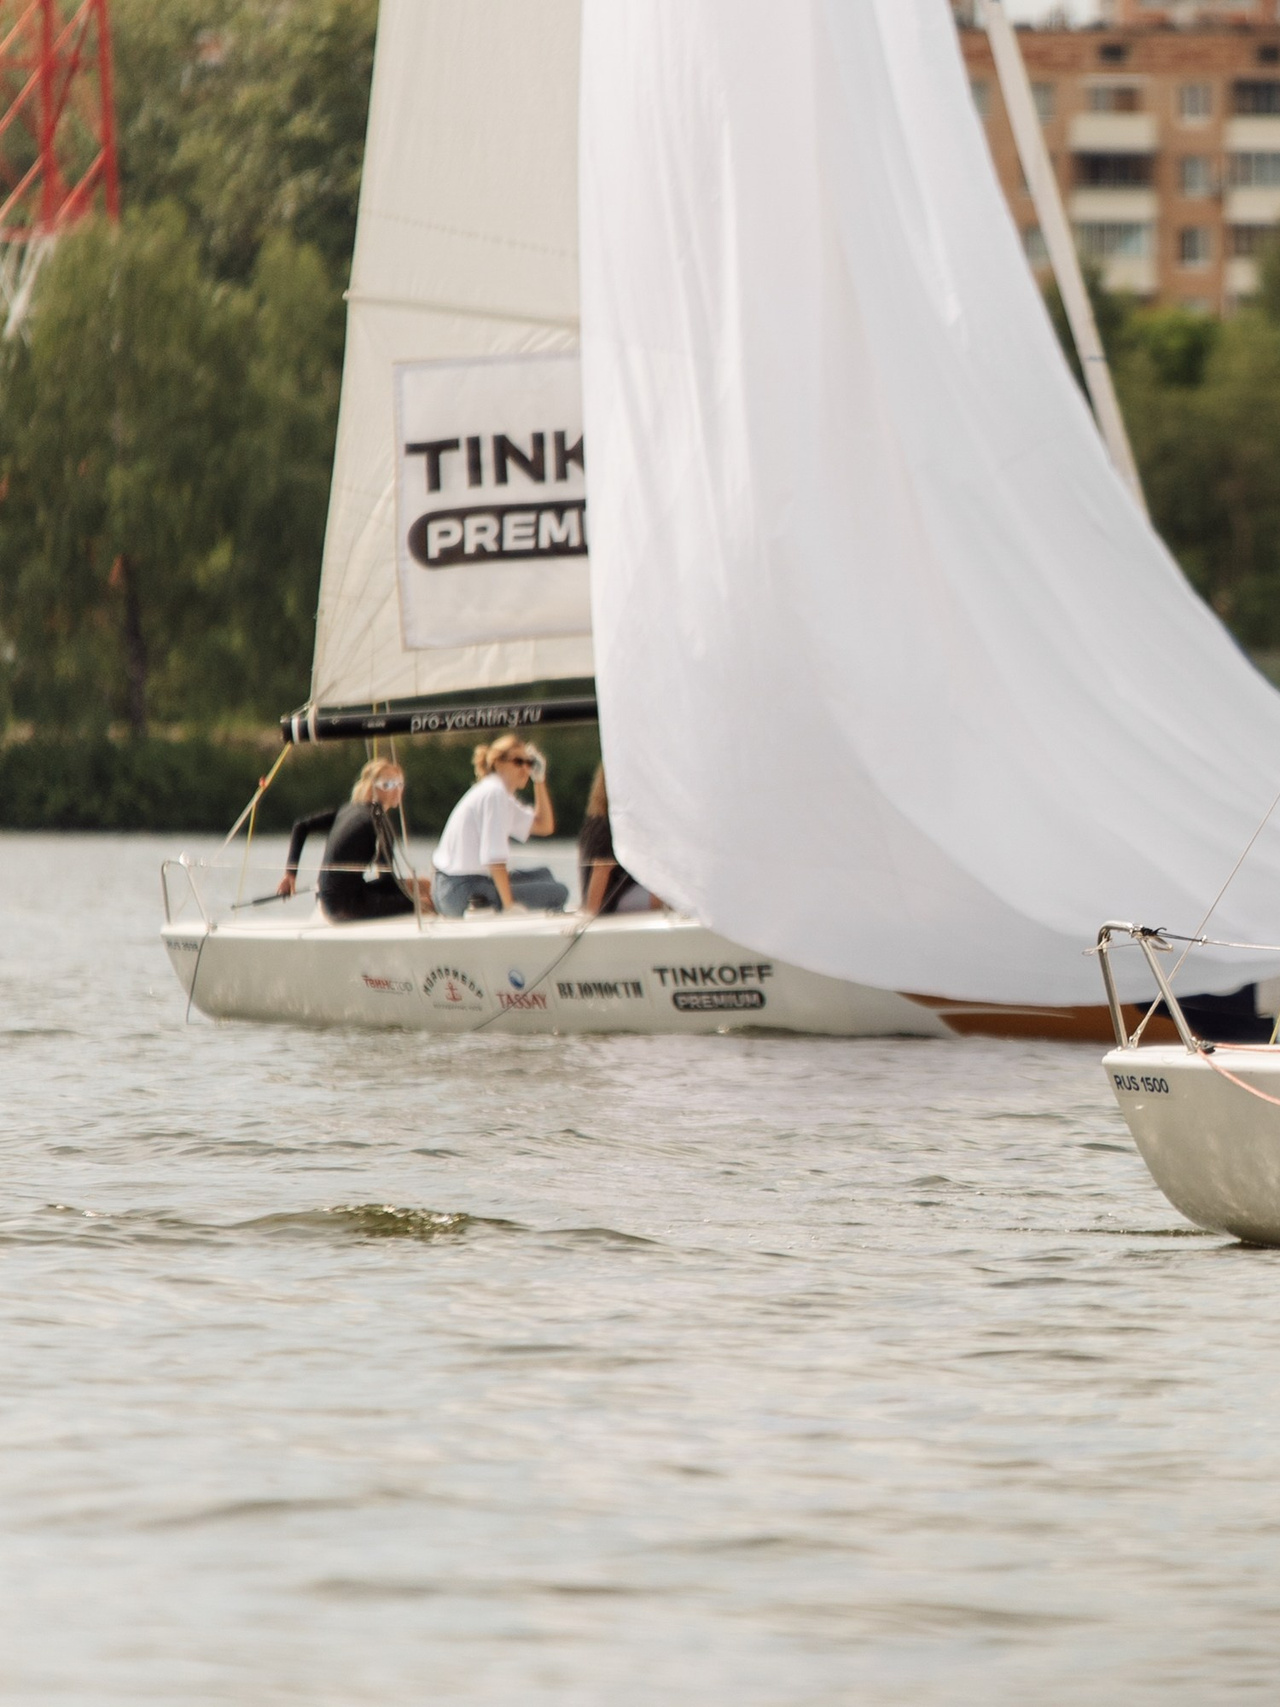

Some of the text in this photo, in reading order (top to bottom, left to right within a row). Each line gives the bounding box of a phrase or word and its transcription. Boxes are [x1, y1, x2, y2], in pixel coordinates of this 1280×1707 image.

[405, 430, 584, 492] TINK
[411, 705, 542, 734] pro-yachting.ru
[653, 965, 772, 987] TINKOFF
[495, 992, 548, 1010] TASSAY
[677, 992, 761, 1010] PREMIUM
[1113, 1075, 1169, 1094] RUS 1500
